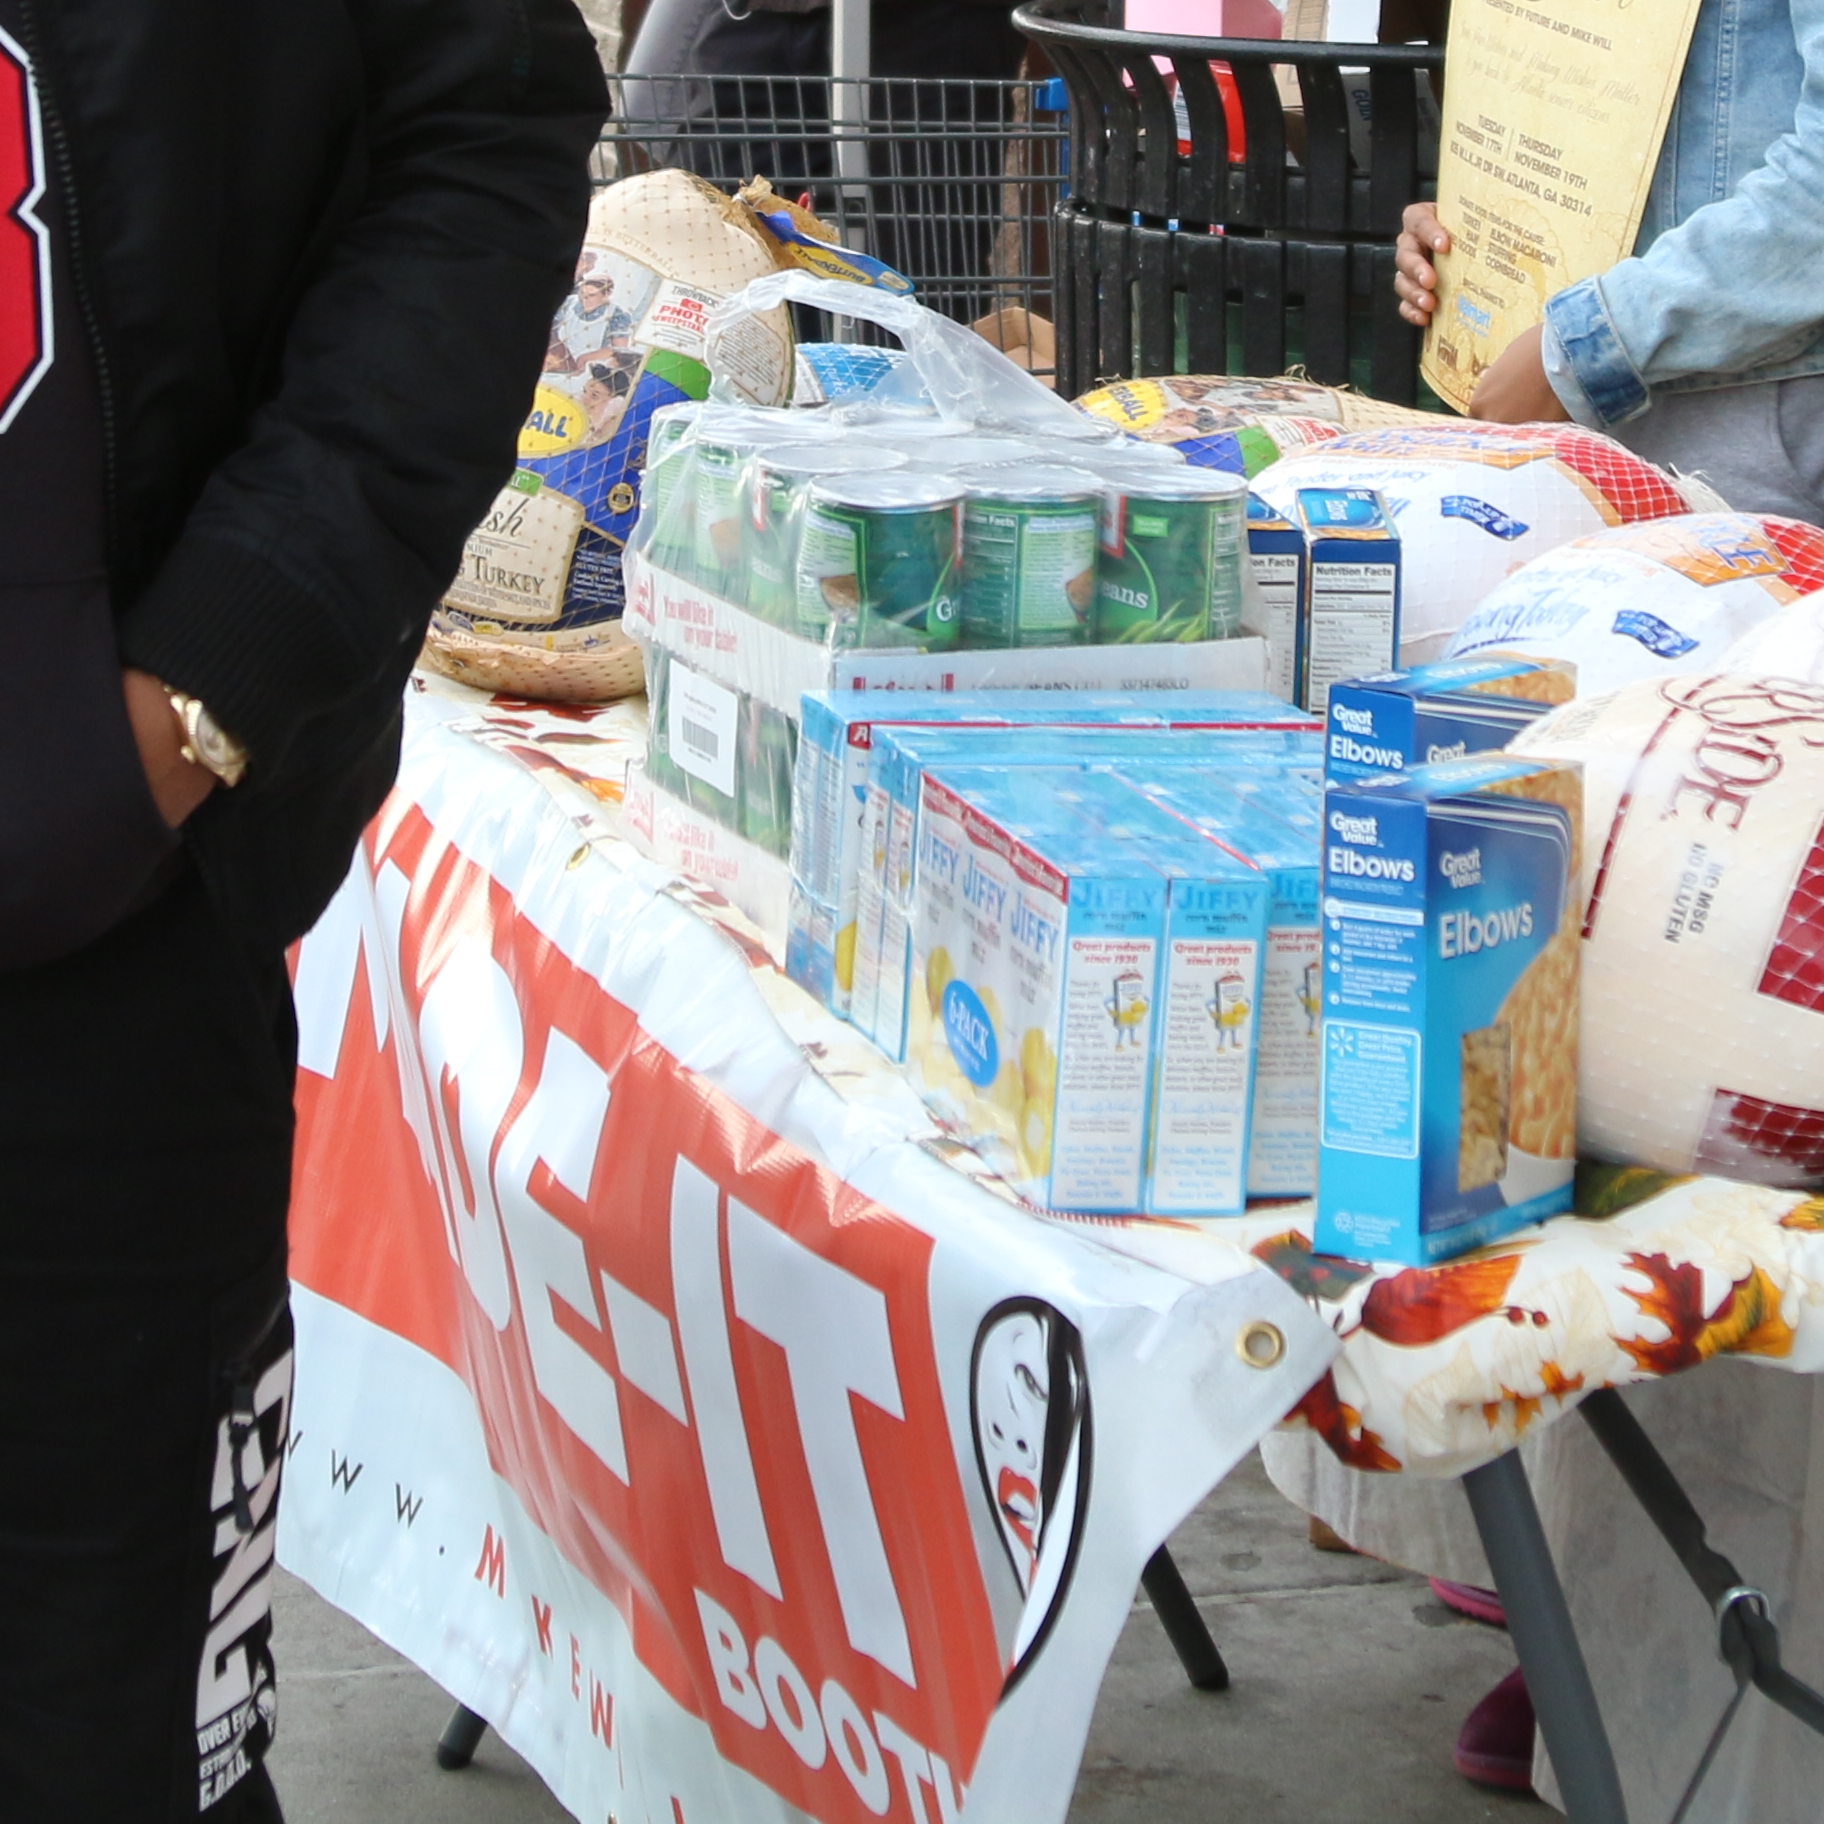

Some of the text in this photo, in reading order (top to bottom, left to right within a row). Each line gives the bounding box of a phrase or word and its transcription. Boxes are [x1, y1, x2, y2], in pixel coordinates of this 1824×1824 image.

[1515, 4, 1525, 18] BY
[1525, 9, 1552, 30] FUTURE
[1551, 21, 1571, 37] AND
[1571, 26, 1593, 44] MIKE
[1592, 35, 1613, 52] WILL
[1478, 114, 1507, 138] TUESDAY
[1485, 136, 1504, 156] 17TH
[1518, 132, 1565, 162] THURSDAY
[1513, 151, 1590, 191] NOVEMBER 19TH
[1542, 187, 1559, 205] GA
[1559, 193, 1594, 218] 30314
[1511, 238, 1558, 269] MACARONI
[1484, 254, 1527, 285] CORNBREAD
[471, 554, 546, 596] TURKEY
[1315, 564, 1394, 578] Nutrition Facts
[1100, 583, 1149, 610] eans
[1332, 702, 1374, 728] Great
[1339, 720, 1374, 738] Value
[1330, 733, 1405, 771] Elbows
[1329, 808, 1379, 836] Great
[1339, 827, 1379, 848] Value
[1328, 846, 1417, 884] Elbows
[1439, 846, 1482, 878] Great
[963, 853, 1007, 924] JIFFY
[1450, 870, 1483, 890] Value
[1076, 881, 1159, 909] JIFFY
[1178, 884, 1259, 911] JIFFY
[1663, 868, 1703, 945] GLUTEN
[1010, 890, 1060, 963] JIFFY
[1688, 890, 1716, 935] MSG
[1296, 929, 1321, 943] prod
[1438, 901, 1534, 960] Elbows
[1072, 940, 1152, 954] Great products
[1084, 953, 1139, 965] since 1930
[1174, 942, 1253, 957] Great products
[1185, 955, 1241, 967] since 1930
[1276, 942, 1303, 954] since
[948, 990, 991, 1063] 6-PACK
